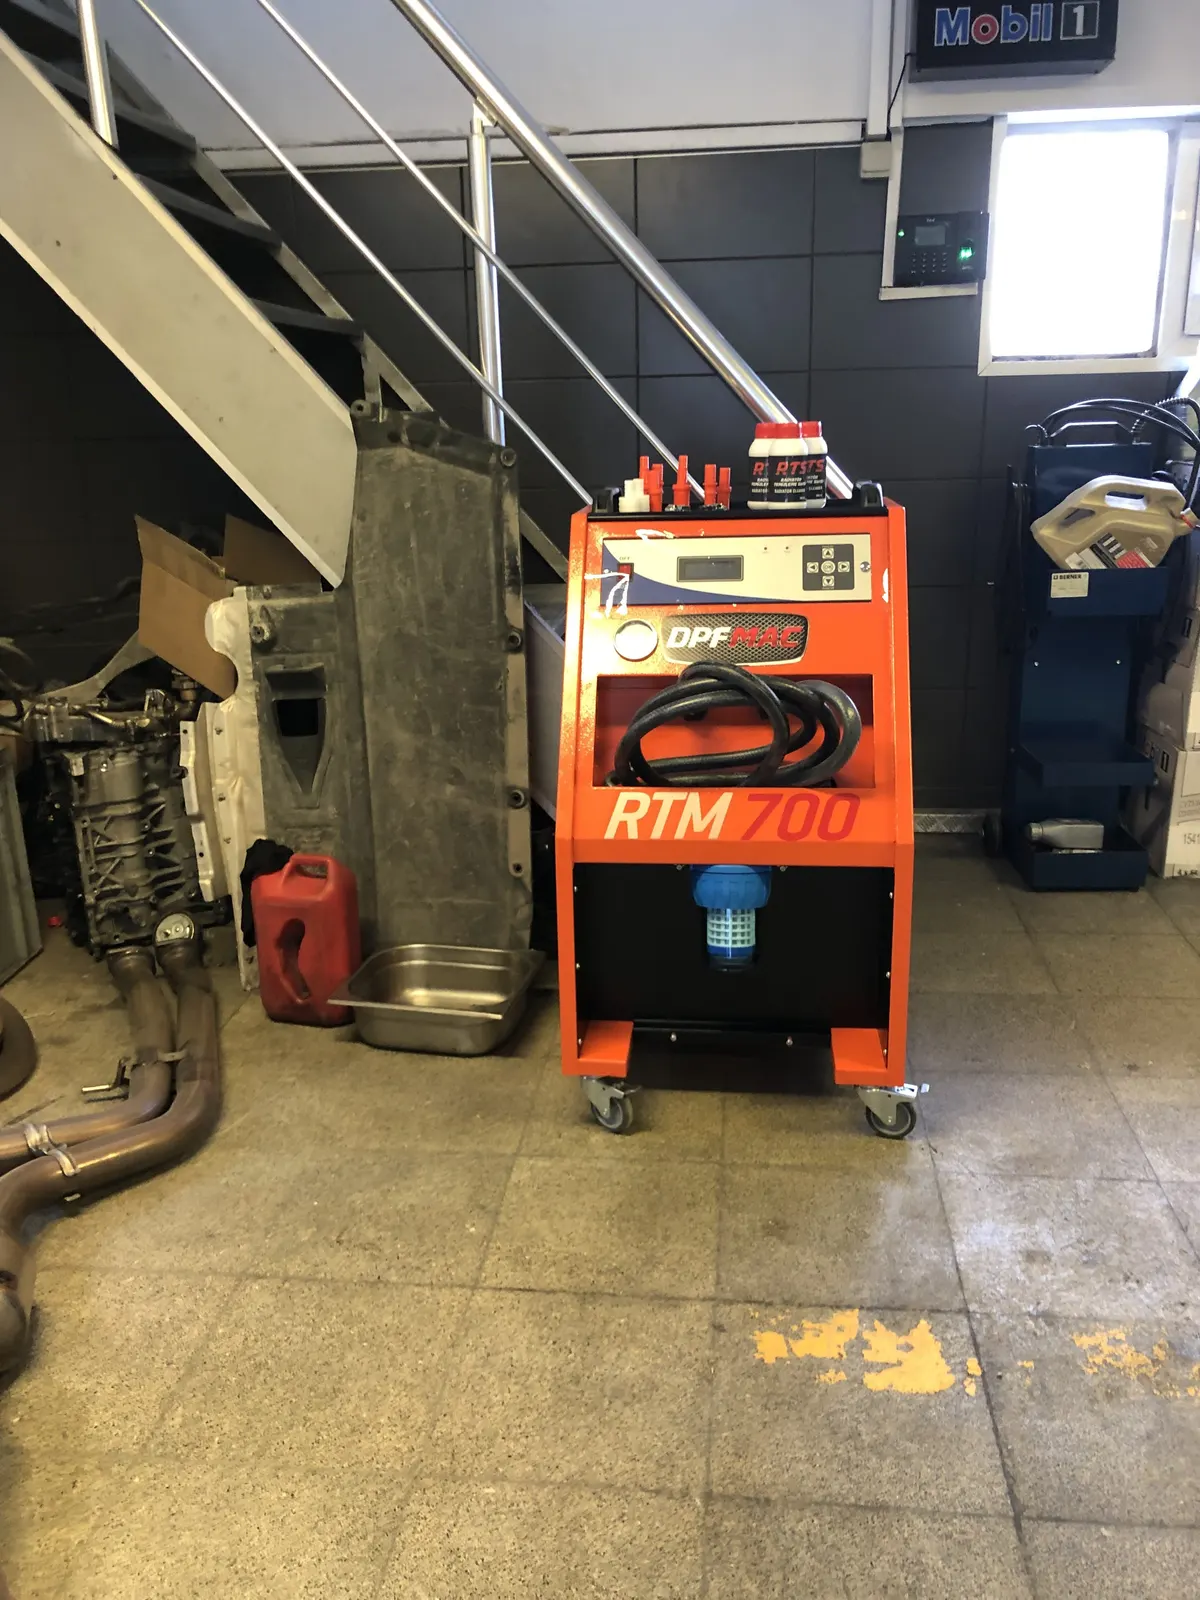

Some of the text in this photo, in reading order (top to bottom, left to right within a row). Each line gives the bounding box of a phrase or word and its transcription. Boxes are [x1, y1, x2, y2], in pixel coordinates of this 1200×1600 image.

[934, 3, 1085, 47] Mobil 1
[604, 791, 861, 841] RTM 700
